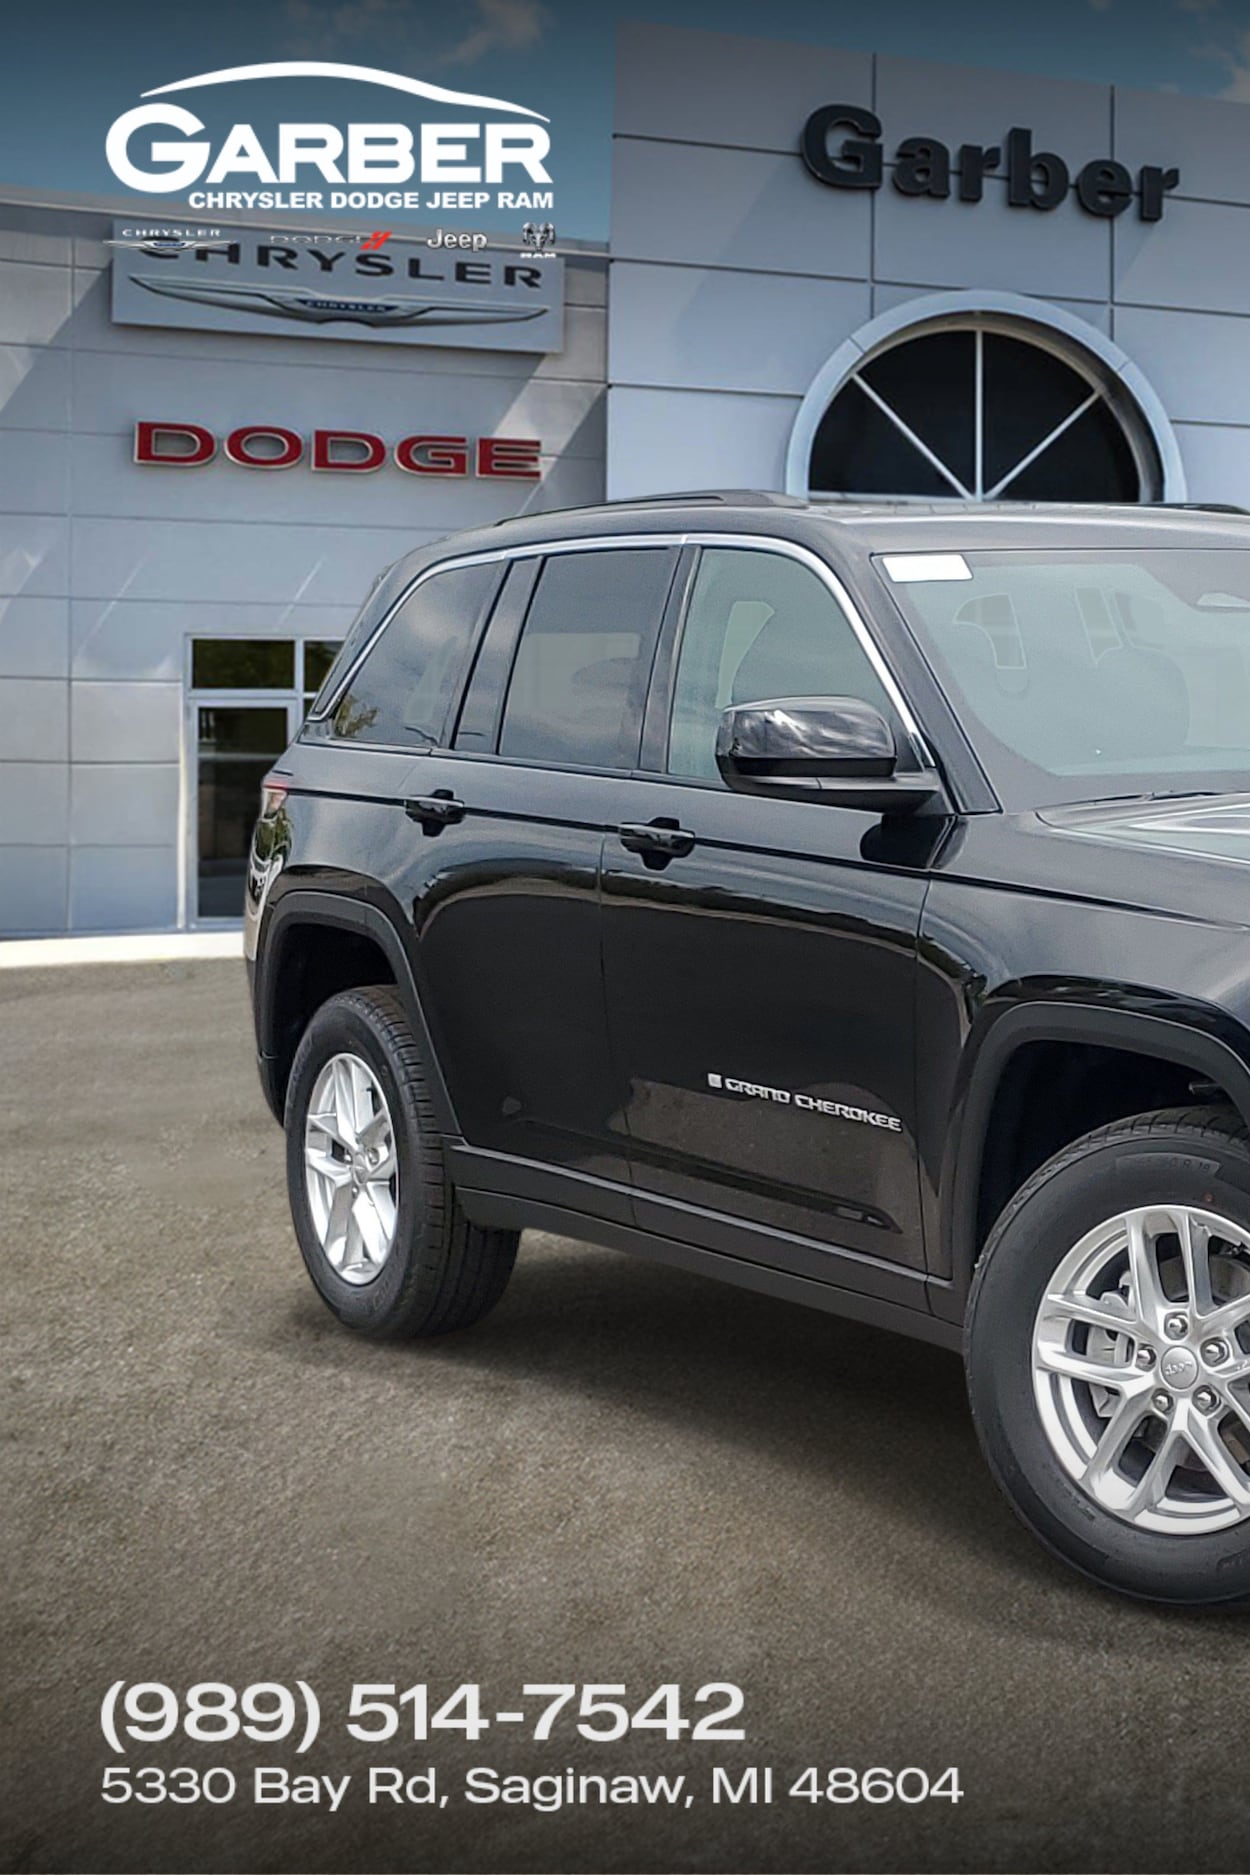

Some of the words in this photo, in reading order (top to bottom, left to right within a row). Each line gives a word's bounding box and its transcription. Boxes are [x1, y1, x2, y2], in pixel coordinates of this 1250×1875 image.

[802, 104, 1179, 222] Garber
[139, 236, 544, 289] CHRYSLER
[133, 421, 542, 480] DODGE
[725, 1077, 791, 1105] GRAND
[794, 1094, 903, 1132] CHEROKEE
